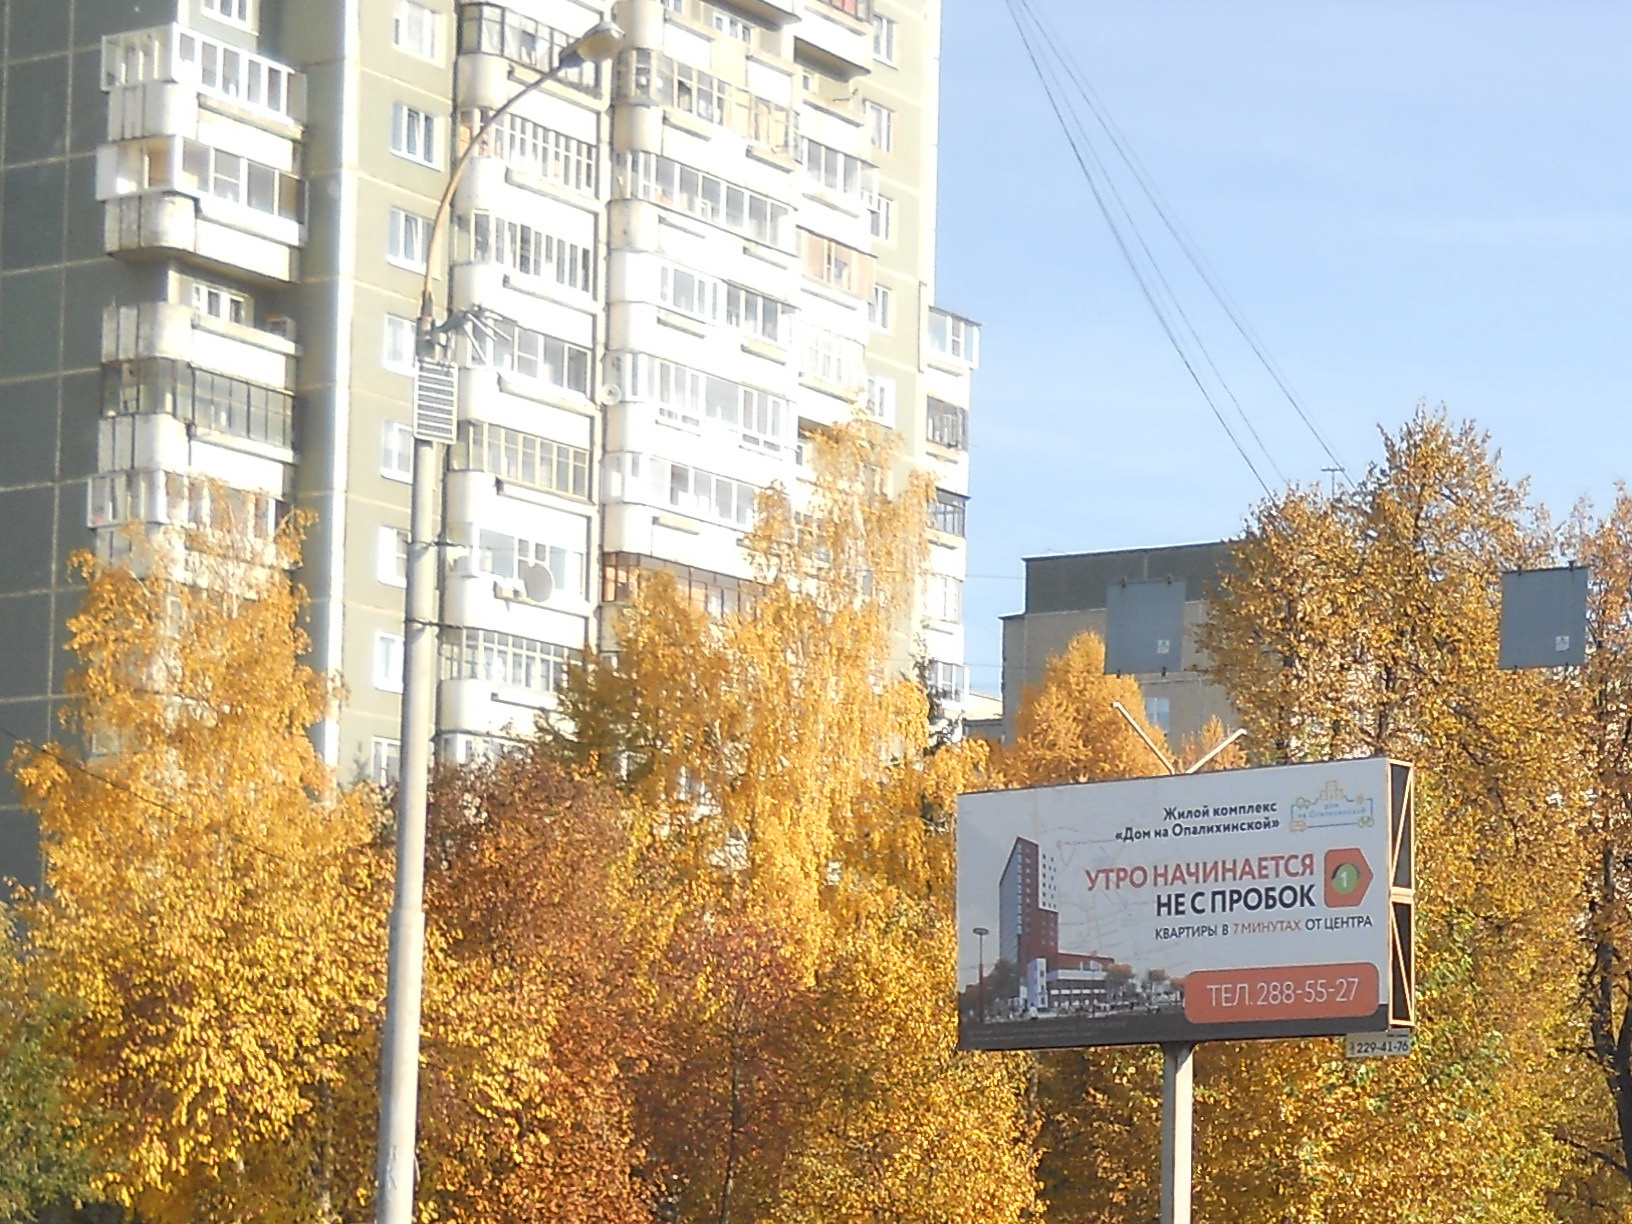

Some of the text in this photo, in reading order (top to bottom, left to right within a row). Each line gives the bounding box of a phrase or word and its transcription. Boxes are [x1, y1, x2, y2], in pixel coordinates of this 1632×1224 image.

[1162, 802, 1278, 822] Жилой комплекс
[1115, 817, 1280, 844] «Дом на Опалихинской»
[1085, 853, 1316, 892] УТРО НАЧИНАЕТСЯ
[1156, 884, 1317, 917] НЕ С ПРОБОК
[1155, 915, 1373, 940] КВАРТИРЫ В 7 МИНУТАХ ОТ ЦЕНТРА
[1207, 977, 1359, 1007] ТЕЛ. 288-55-27
[1357, 1040, 1410, 1054] 229-41-76
